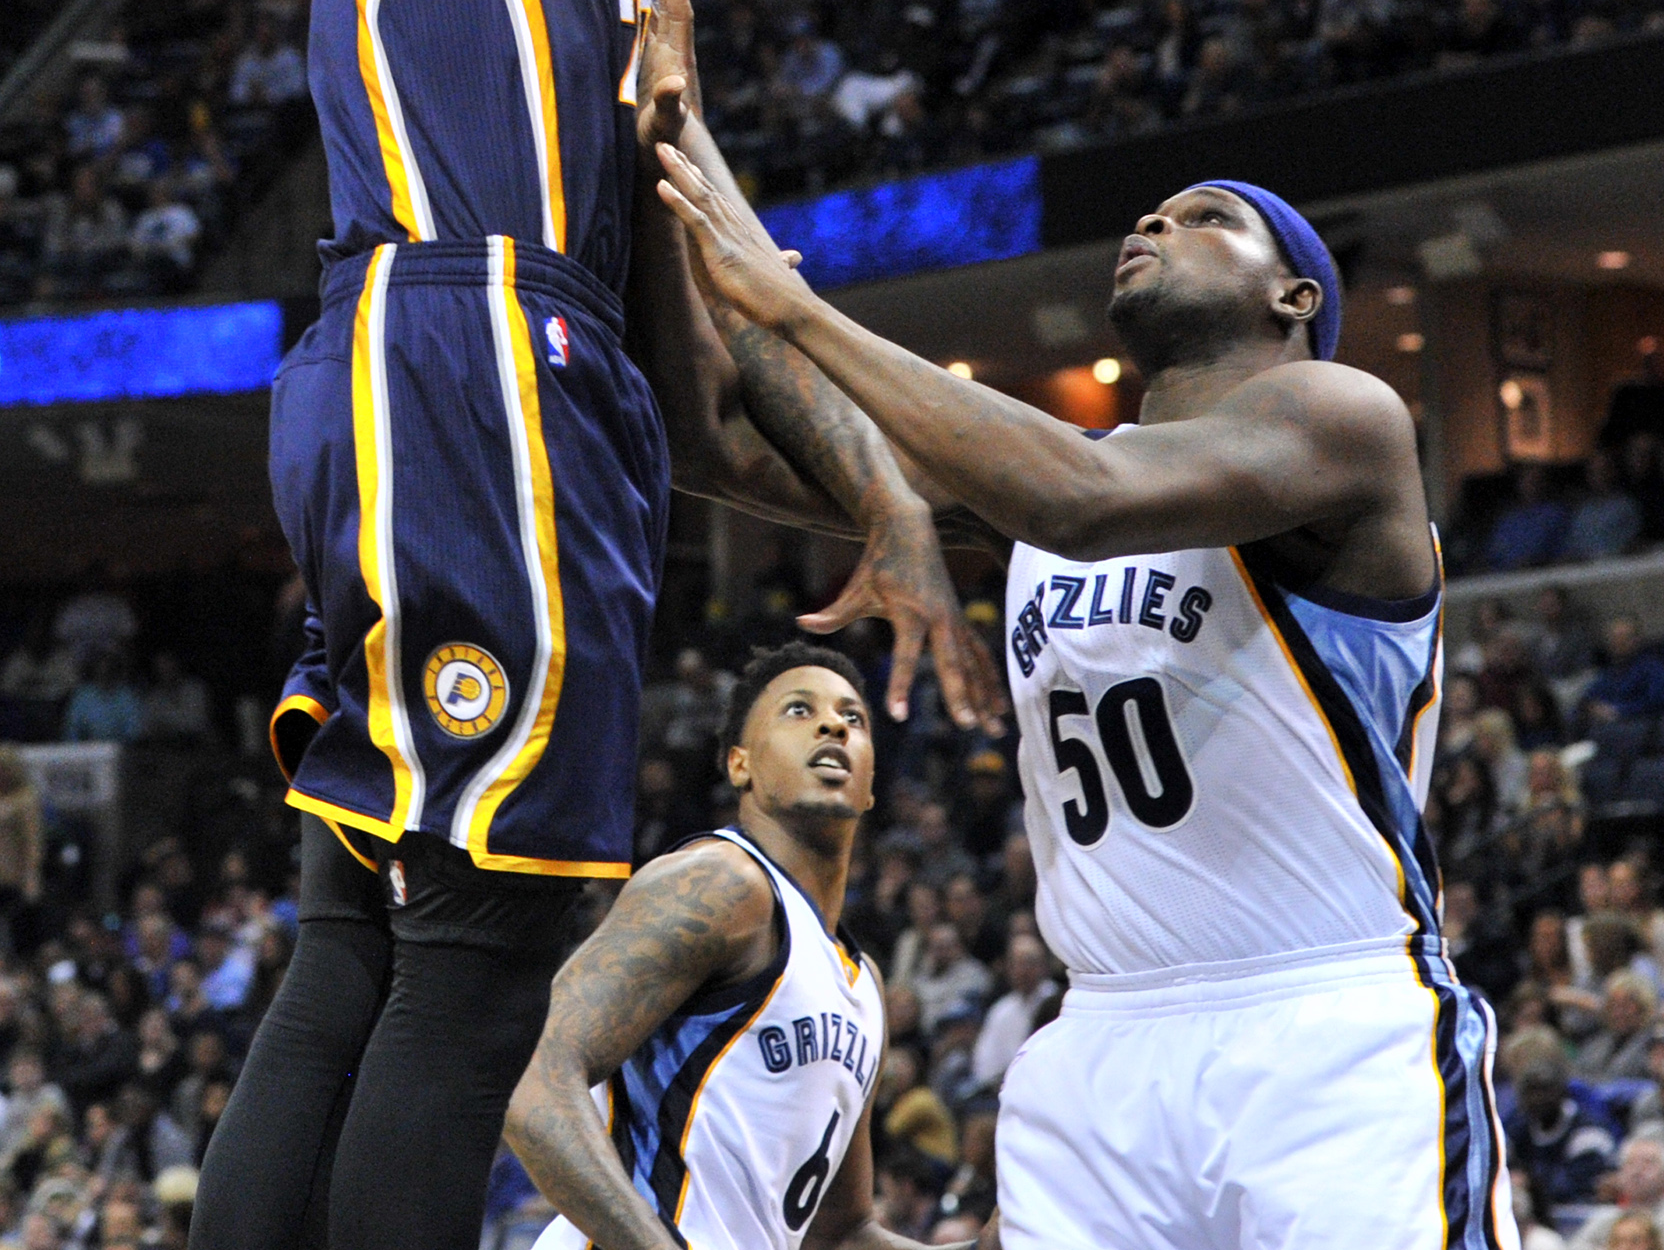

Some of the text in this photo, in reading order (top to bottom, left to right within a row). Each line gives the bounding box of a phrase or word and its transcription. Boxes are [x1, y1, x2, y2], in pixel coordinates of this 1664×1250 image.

[1048, 676, 1194, 847] 50
[757, 1011, 877, 1099] GRIZZLI
[782, 1108, 841, 1232] 6
